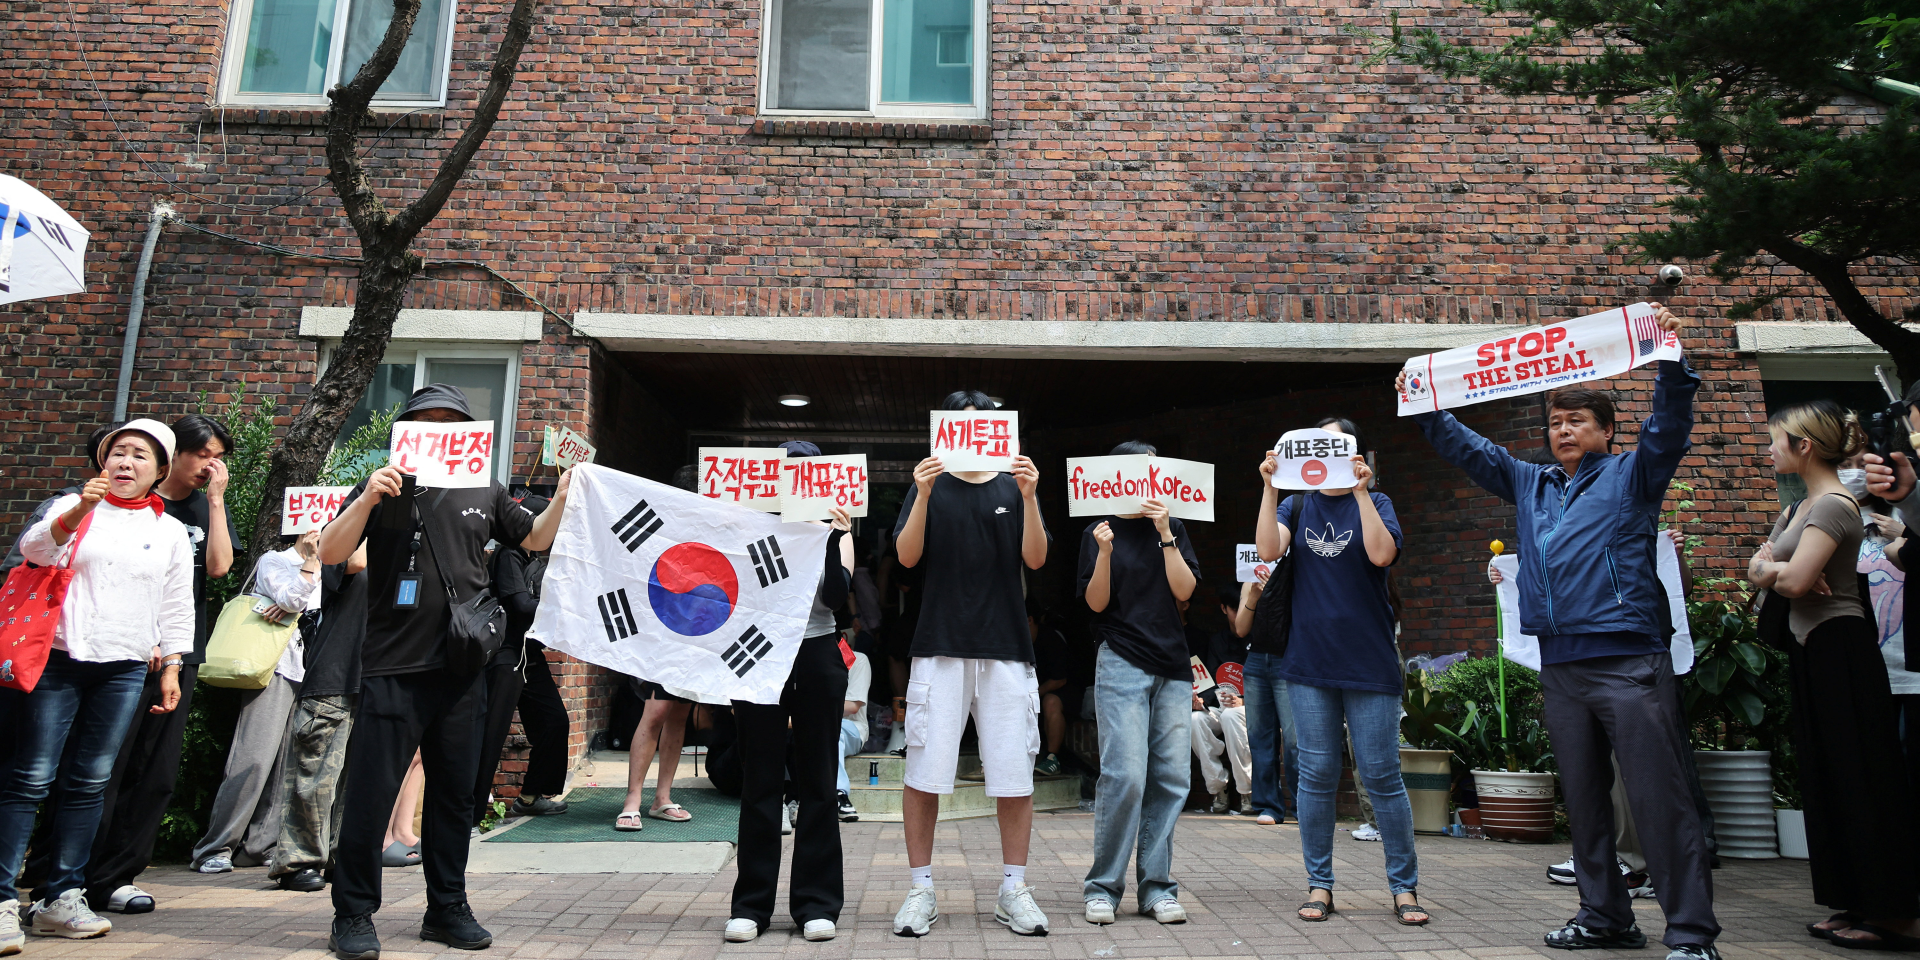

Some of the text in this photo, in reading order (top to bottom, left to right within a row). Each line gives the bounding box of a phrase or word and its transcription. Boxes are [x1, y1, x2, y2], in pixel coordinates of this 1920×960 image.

[1477, 327, 1574, 367] STOP.
[1463, 350, 1593, 390] THE STEAL
[1488, 375, 1570, 395] STAND WITH YOON
[396, 430, 493, 475] 선거부정
[935, 418, 1012, 458] 사기투표
[1277, 438, 1351, 459] 개표중단
[703, 455, 781, 502] 조작투표
[784, 461, 867, 507] 개표중단
